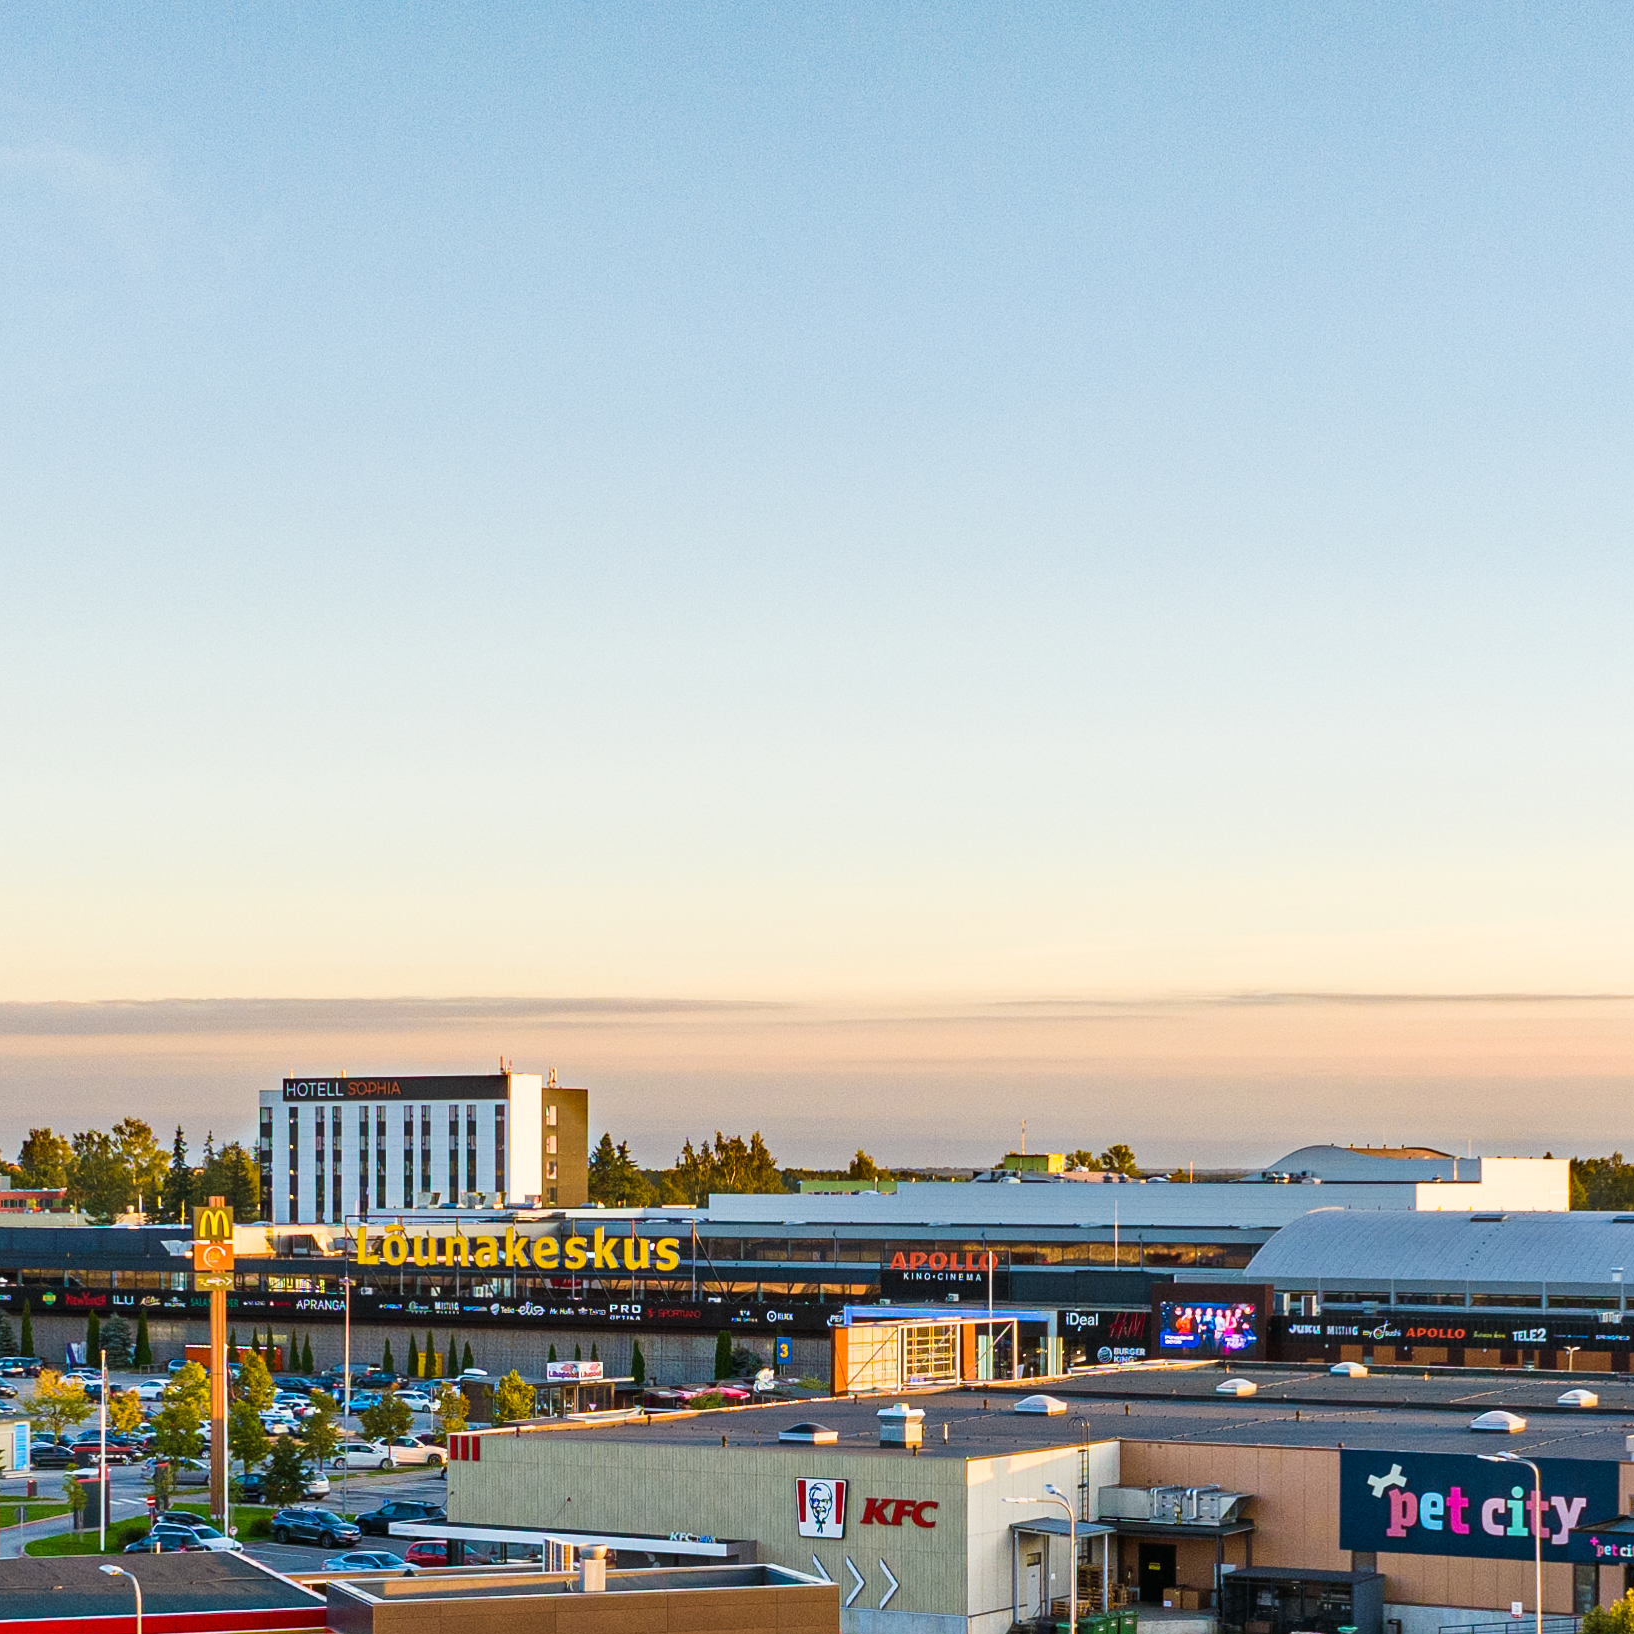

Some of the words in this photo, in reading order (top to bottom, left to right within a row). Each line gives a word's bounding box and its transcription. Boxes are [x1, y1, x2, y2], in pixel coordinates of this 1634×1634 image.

[285, 1081, 345, 1098] HOTELL
[347, 1080, 402, 1097] SOPHIA
[357, 1224, 681, 1271] Lõunakeskus
[890, 1251, 999, 1271] APOLLO
[190, 1297, 239, 1308] SALADER
[296, 1299, 346, 1311] APRANGA
[609, 1304, 642, 1314] PRO
[1065, 1312, 1099, 1326] iDeal
[1406, 1327, 1466, 1339] APOLLO
[1512, 1328, 1547, 1343] TELE2
[779, 1343, 789, 1358] 3
[1113, 1347, 1146, 1356] BURGER
[860, 1497, 939, 1528] KFC
[1385, 1486, 1470, 1538] pet
[1481, 1486, 1588, 1545] city
[669, 1531, 694, 1542] KFC
[1596, 1543, 1619, 1559] pet
